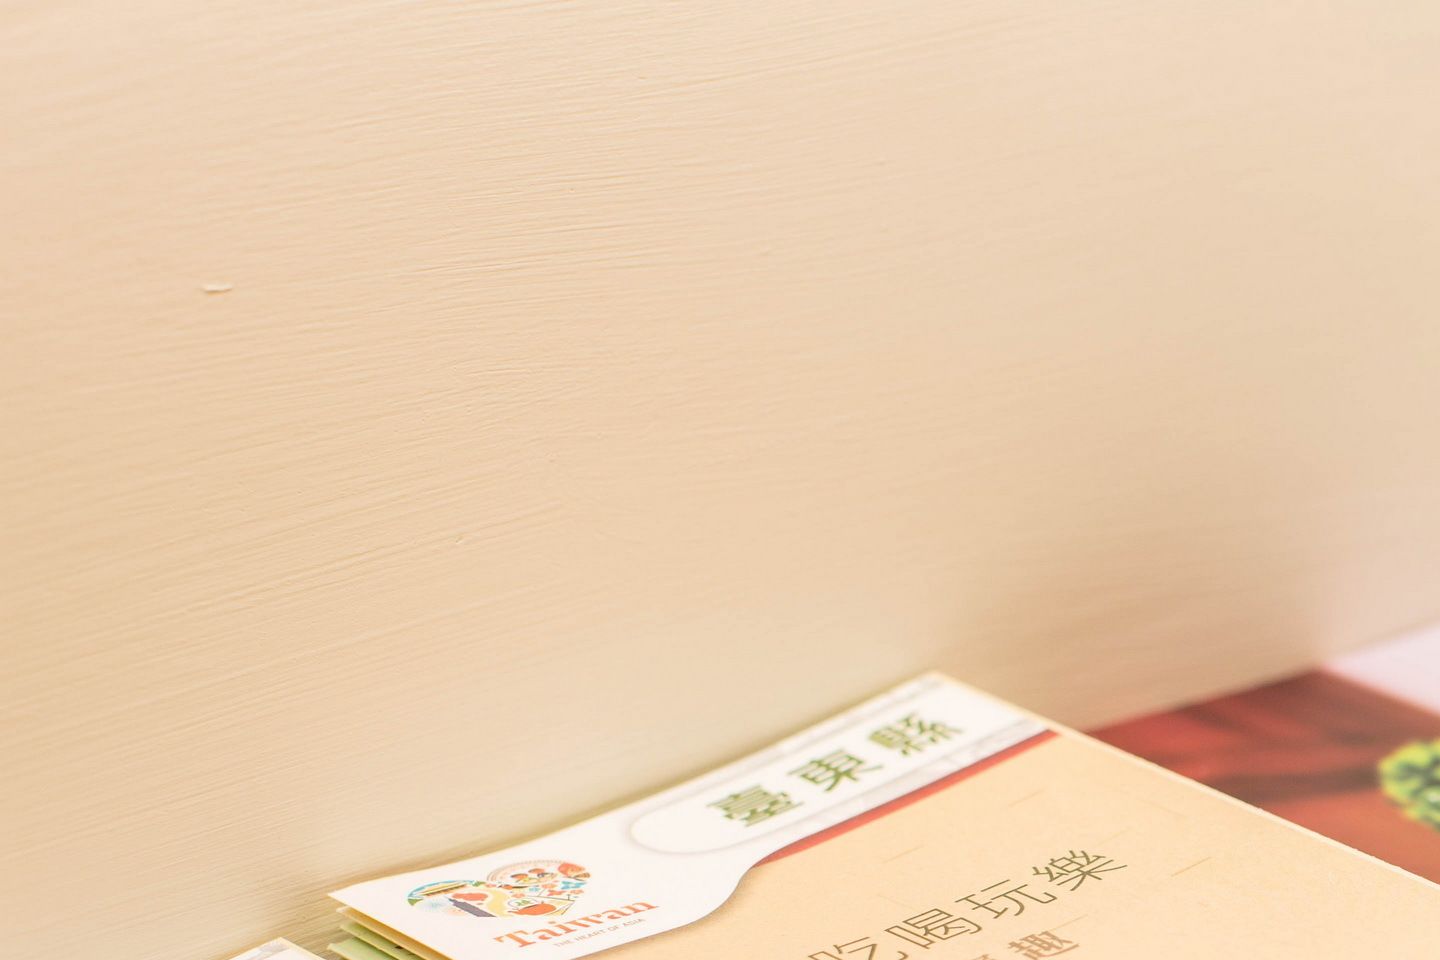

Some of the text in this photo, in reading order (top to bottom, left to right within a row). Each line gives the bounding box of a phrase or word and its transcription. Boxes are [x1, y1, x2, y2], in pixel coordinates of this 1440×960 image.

[706, 712, 963, 827] 臺東縣
[494, 900, 658, 948] Taiwan
